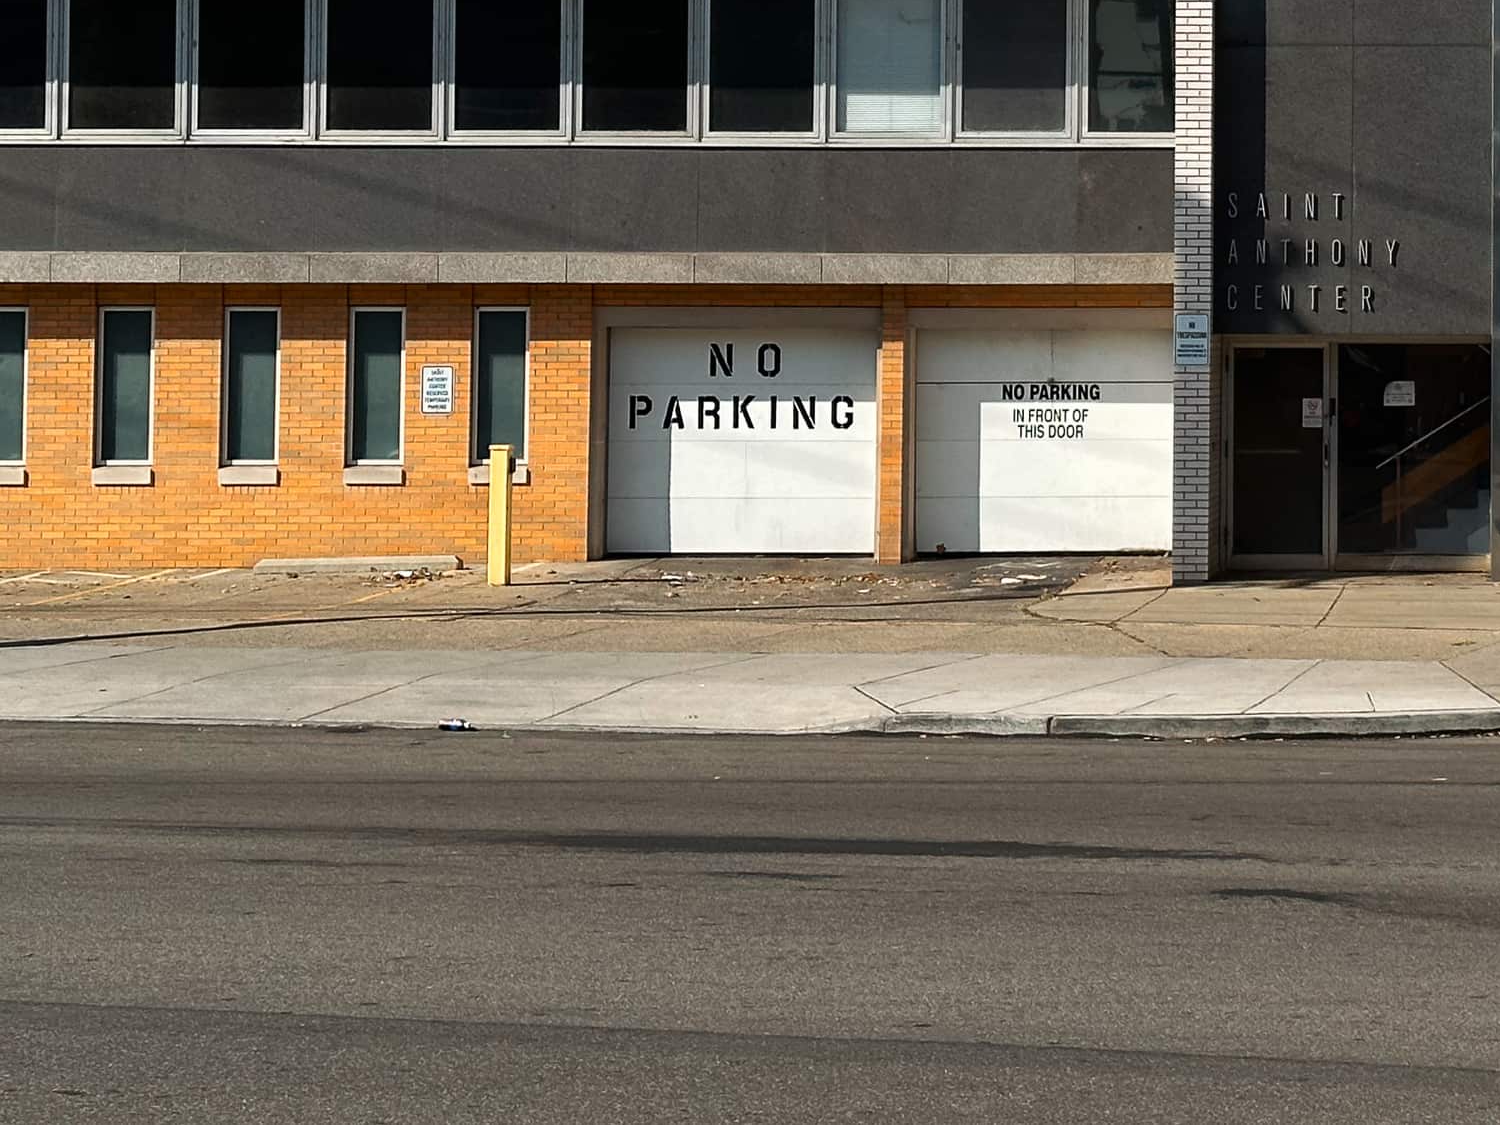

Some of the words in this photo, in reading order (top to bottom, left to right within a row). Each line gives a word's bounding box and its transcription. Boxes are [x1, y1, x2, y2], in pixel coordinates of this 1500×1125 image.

[1227, 192, 1342, 219] SAINT
[1228, 238, 1397, 265] ANTHONY
[1227, 284, 1373, 312] CENTER
[709, 343, 781, 377] NO
[1002, 384, 1025, 400] NO
[1030, 384, 1100, 400] PARKING
[628, 395, 854, 430] PARKING
[1013, 408, 1025, 422] IN
[1028, 408, 1070, 422] FRONT
[1072, 408, 1089, 422] OF
[1017, 424, 1045, 438] THIS
[1048, 424, 1084, 438] DOOR
